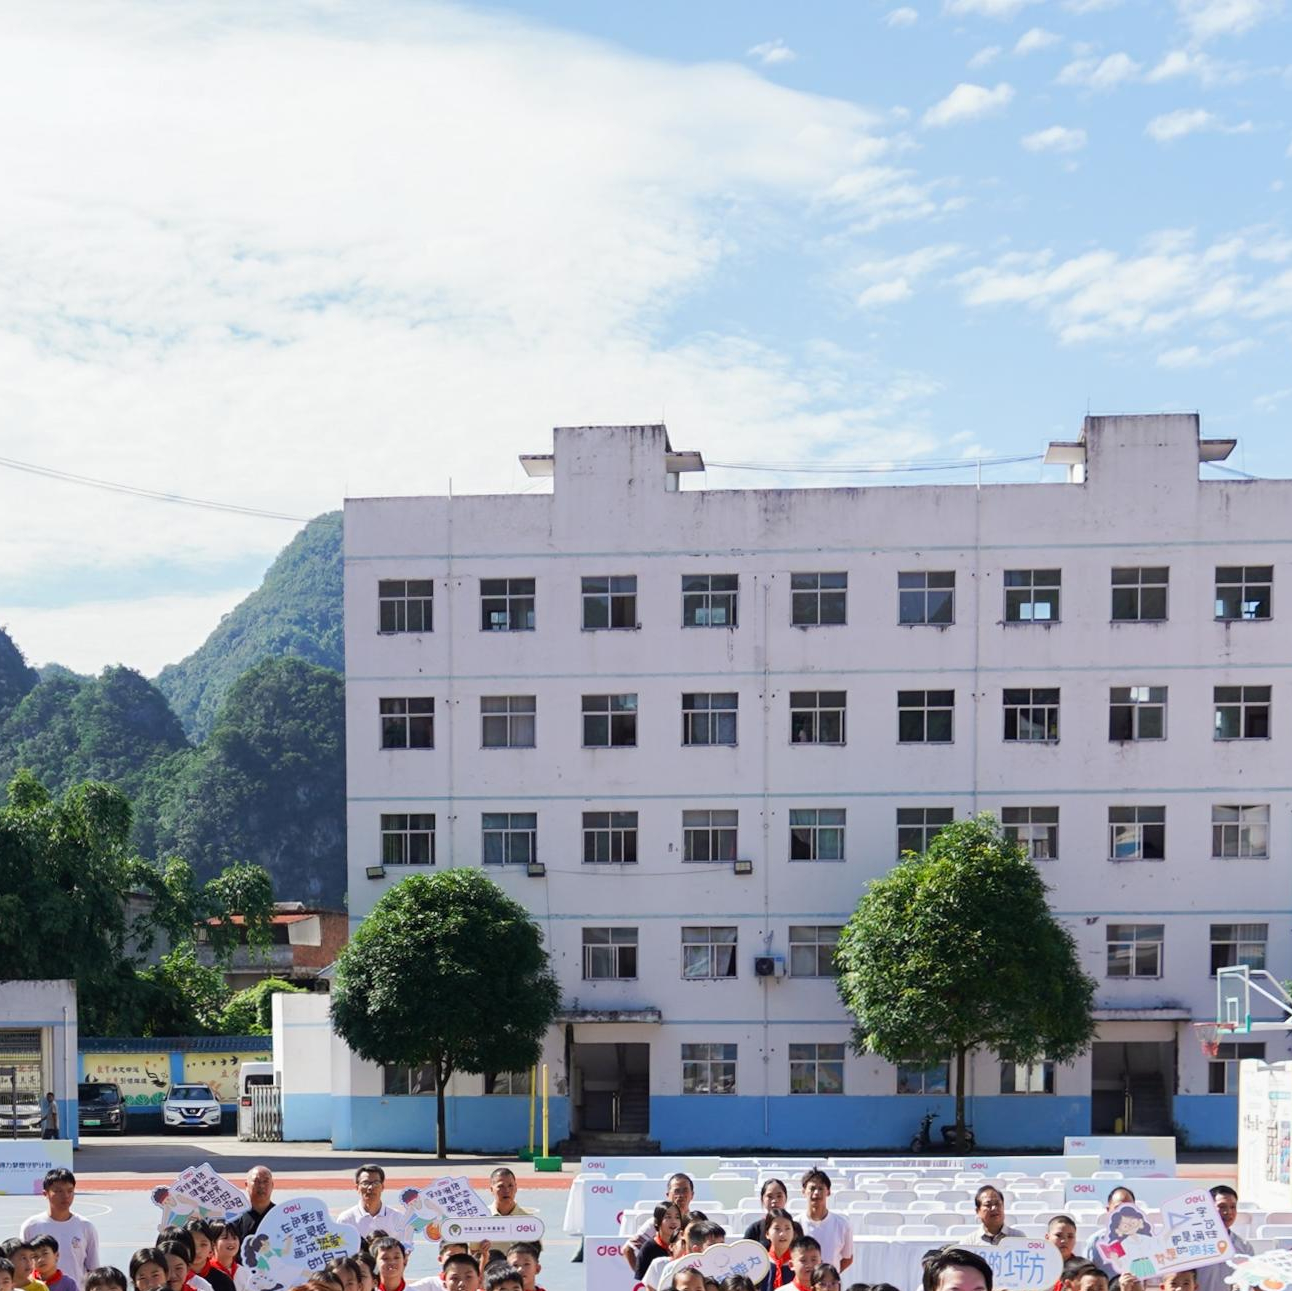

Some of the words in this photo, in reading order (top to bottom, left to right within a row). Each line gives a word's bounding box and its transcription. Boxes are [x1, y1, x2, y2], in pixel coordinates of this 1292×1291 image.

[588, 1161, 605, 1169] deli
[592, 1185, 613, 1194] deli
[1073, 1184, 1095, 1193] deli
[1185, 1195, 1205, 1205] deli
[516, 1223, 536, 1232] deli
[1028, 1242, 1045, 1250] deli
[597, 1245, 625, 1257] del
